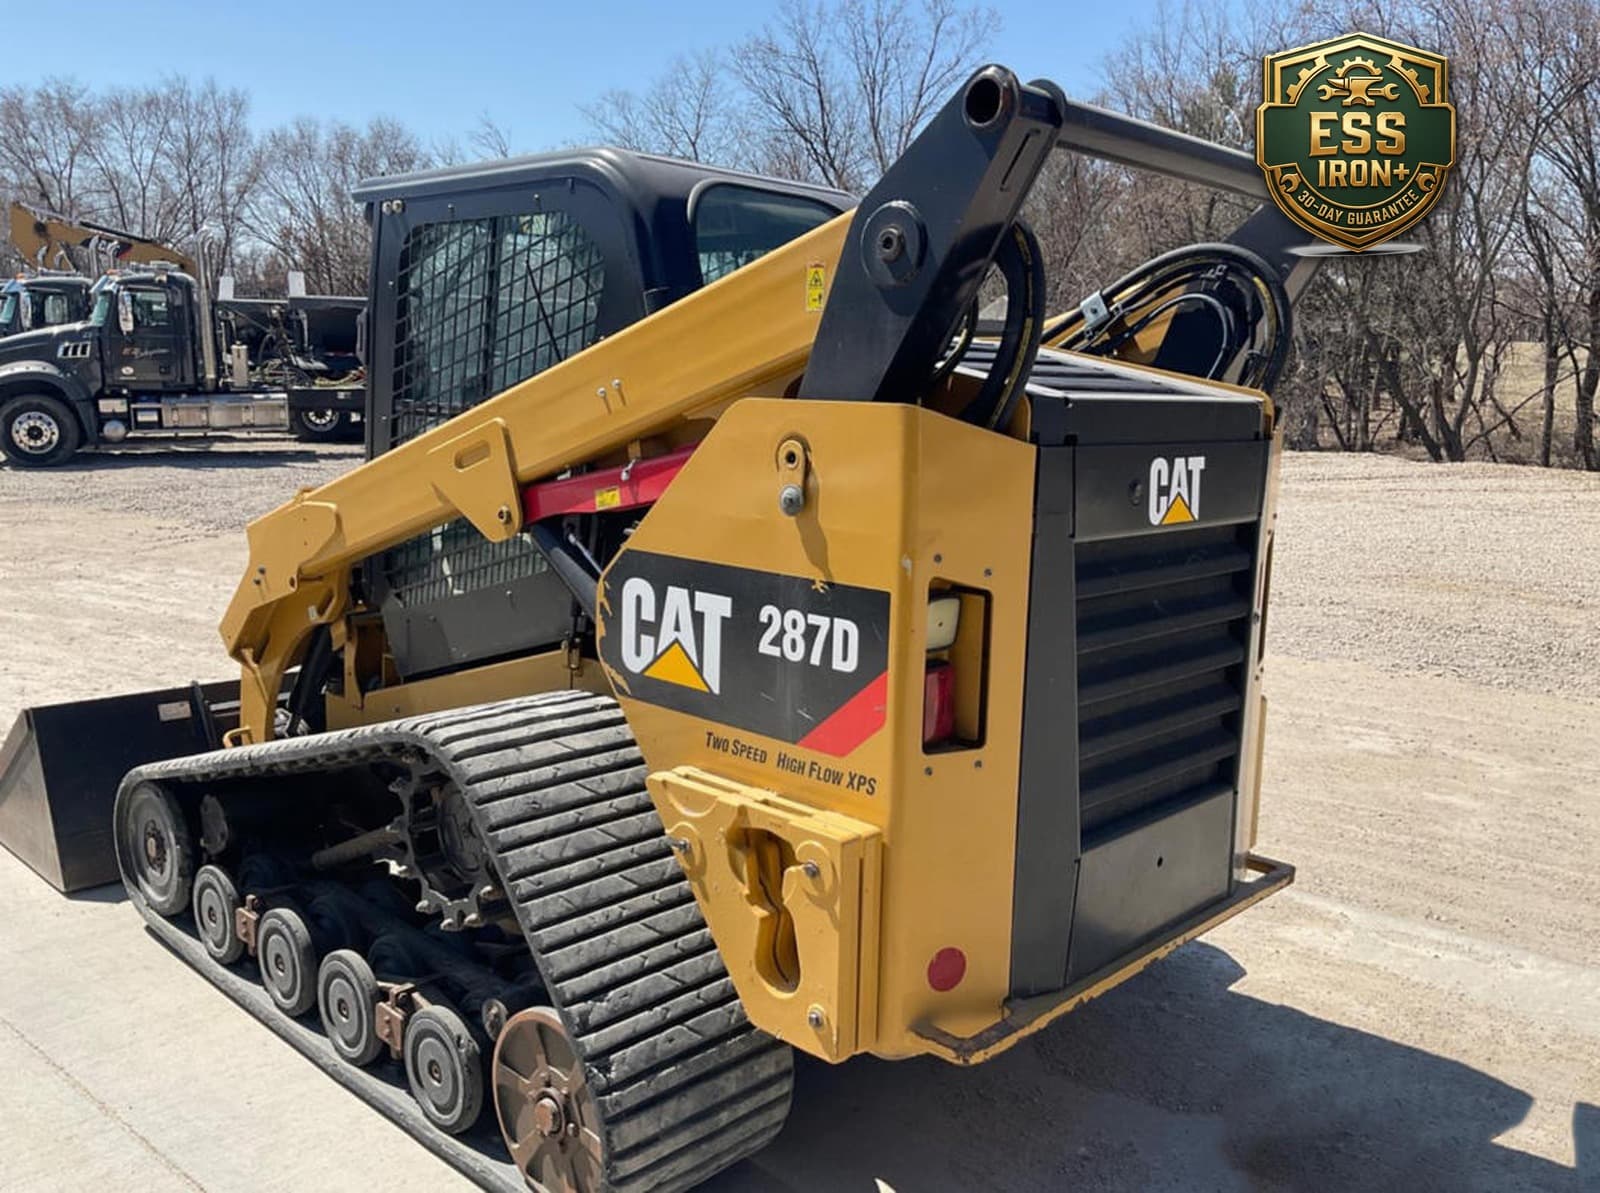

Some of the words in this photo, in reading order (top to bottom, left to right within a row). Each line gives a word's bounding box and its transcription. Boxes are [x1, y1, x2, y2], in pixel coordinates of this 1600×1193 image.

[1149, 456, 1206, 526] CAT
[621, 577, 733, 695] CAT
[758, 604, 860, 673] 287D
[846, 771, 878, 797] XPS
